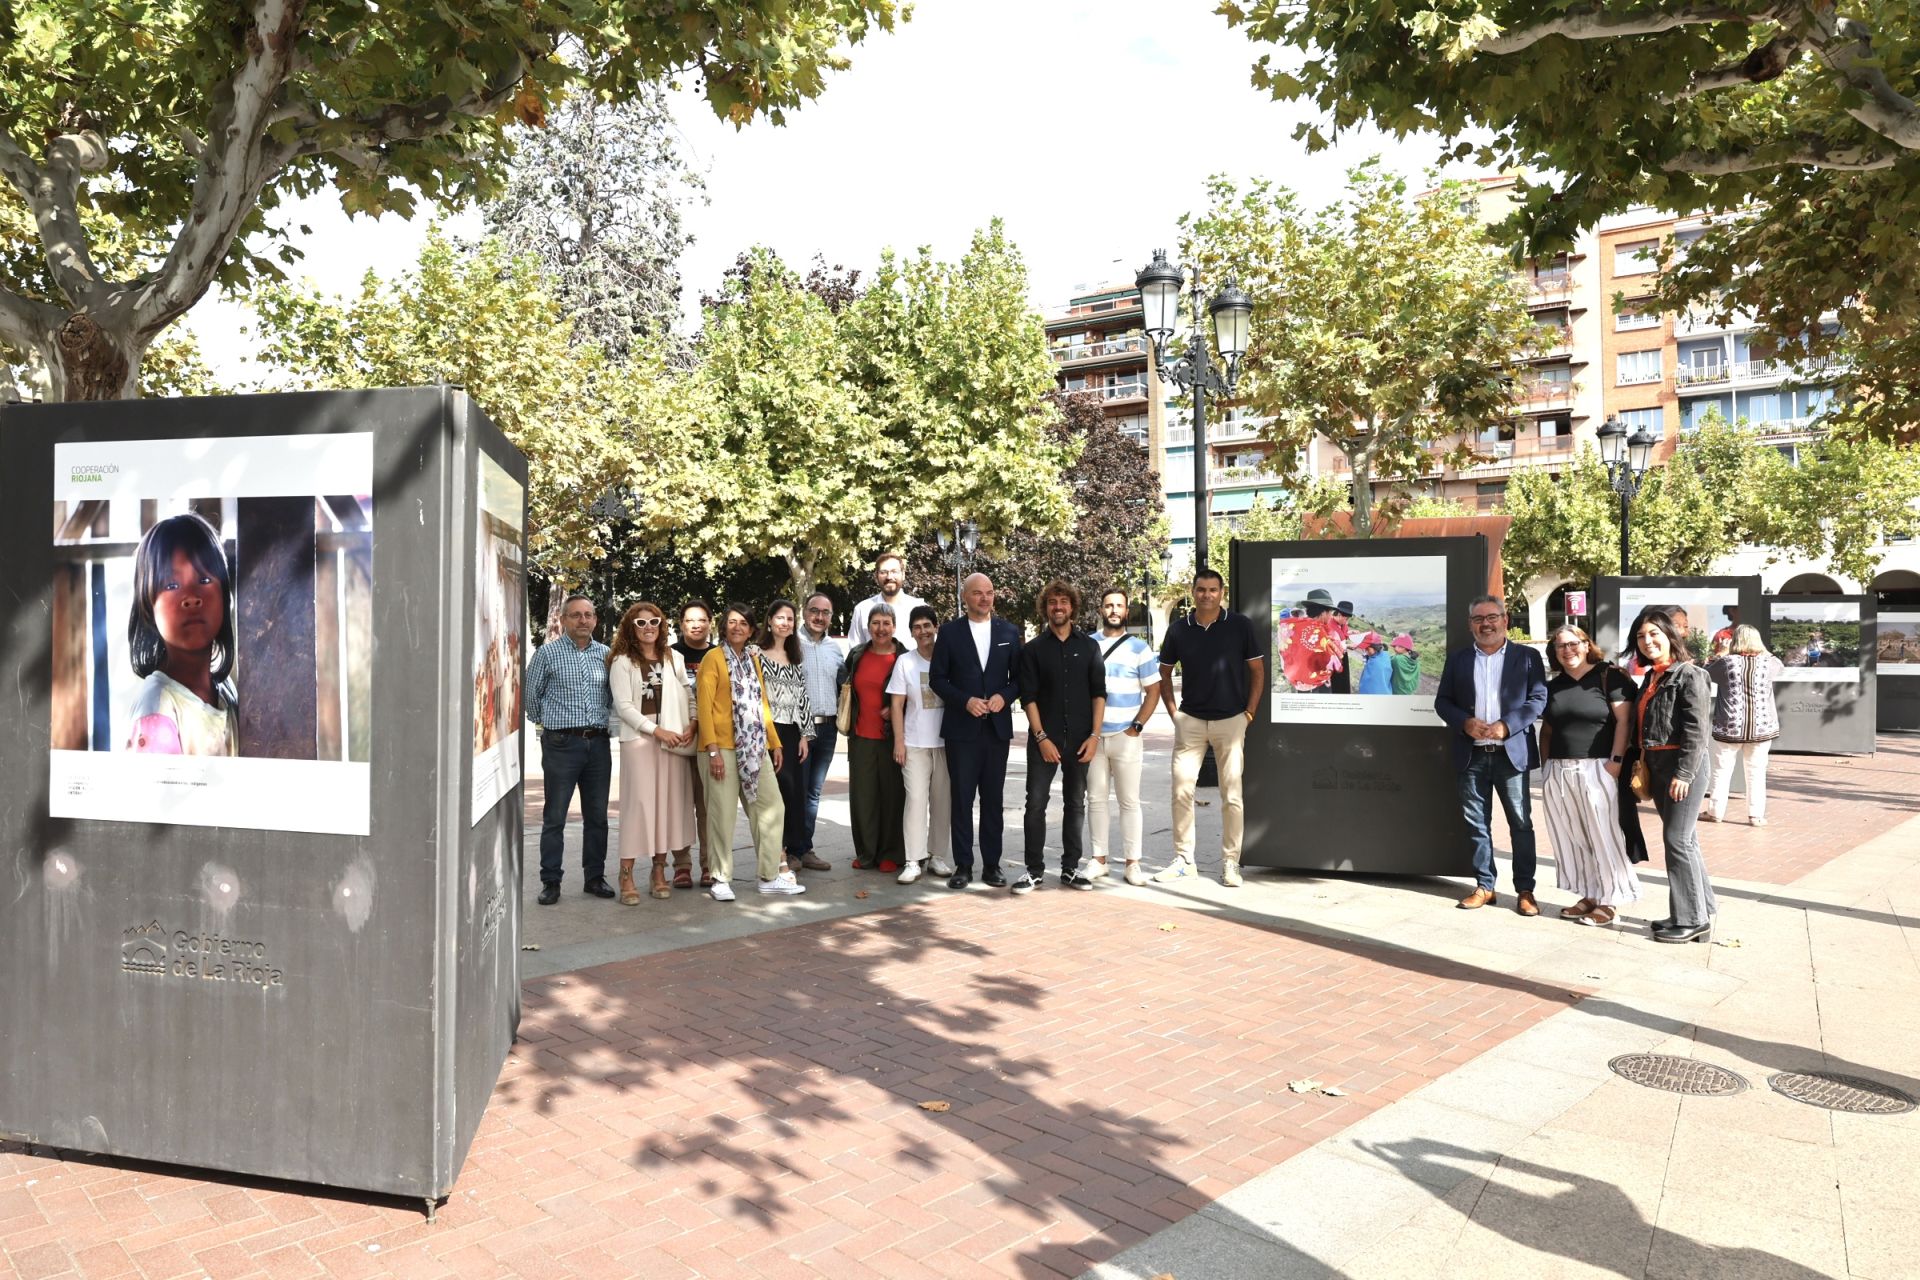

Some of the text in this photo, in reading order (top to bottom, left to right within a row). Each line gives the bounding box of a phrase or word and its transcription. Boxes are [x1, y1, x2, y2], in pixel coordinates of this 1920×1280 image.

[71, 474, 103, 483] RIOJANA
[172, 930, 266, 959] Gobierno
[172, 956, 283, 988] de La Rioja
